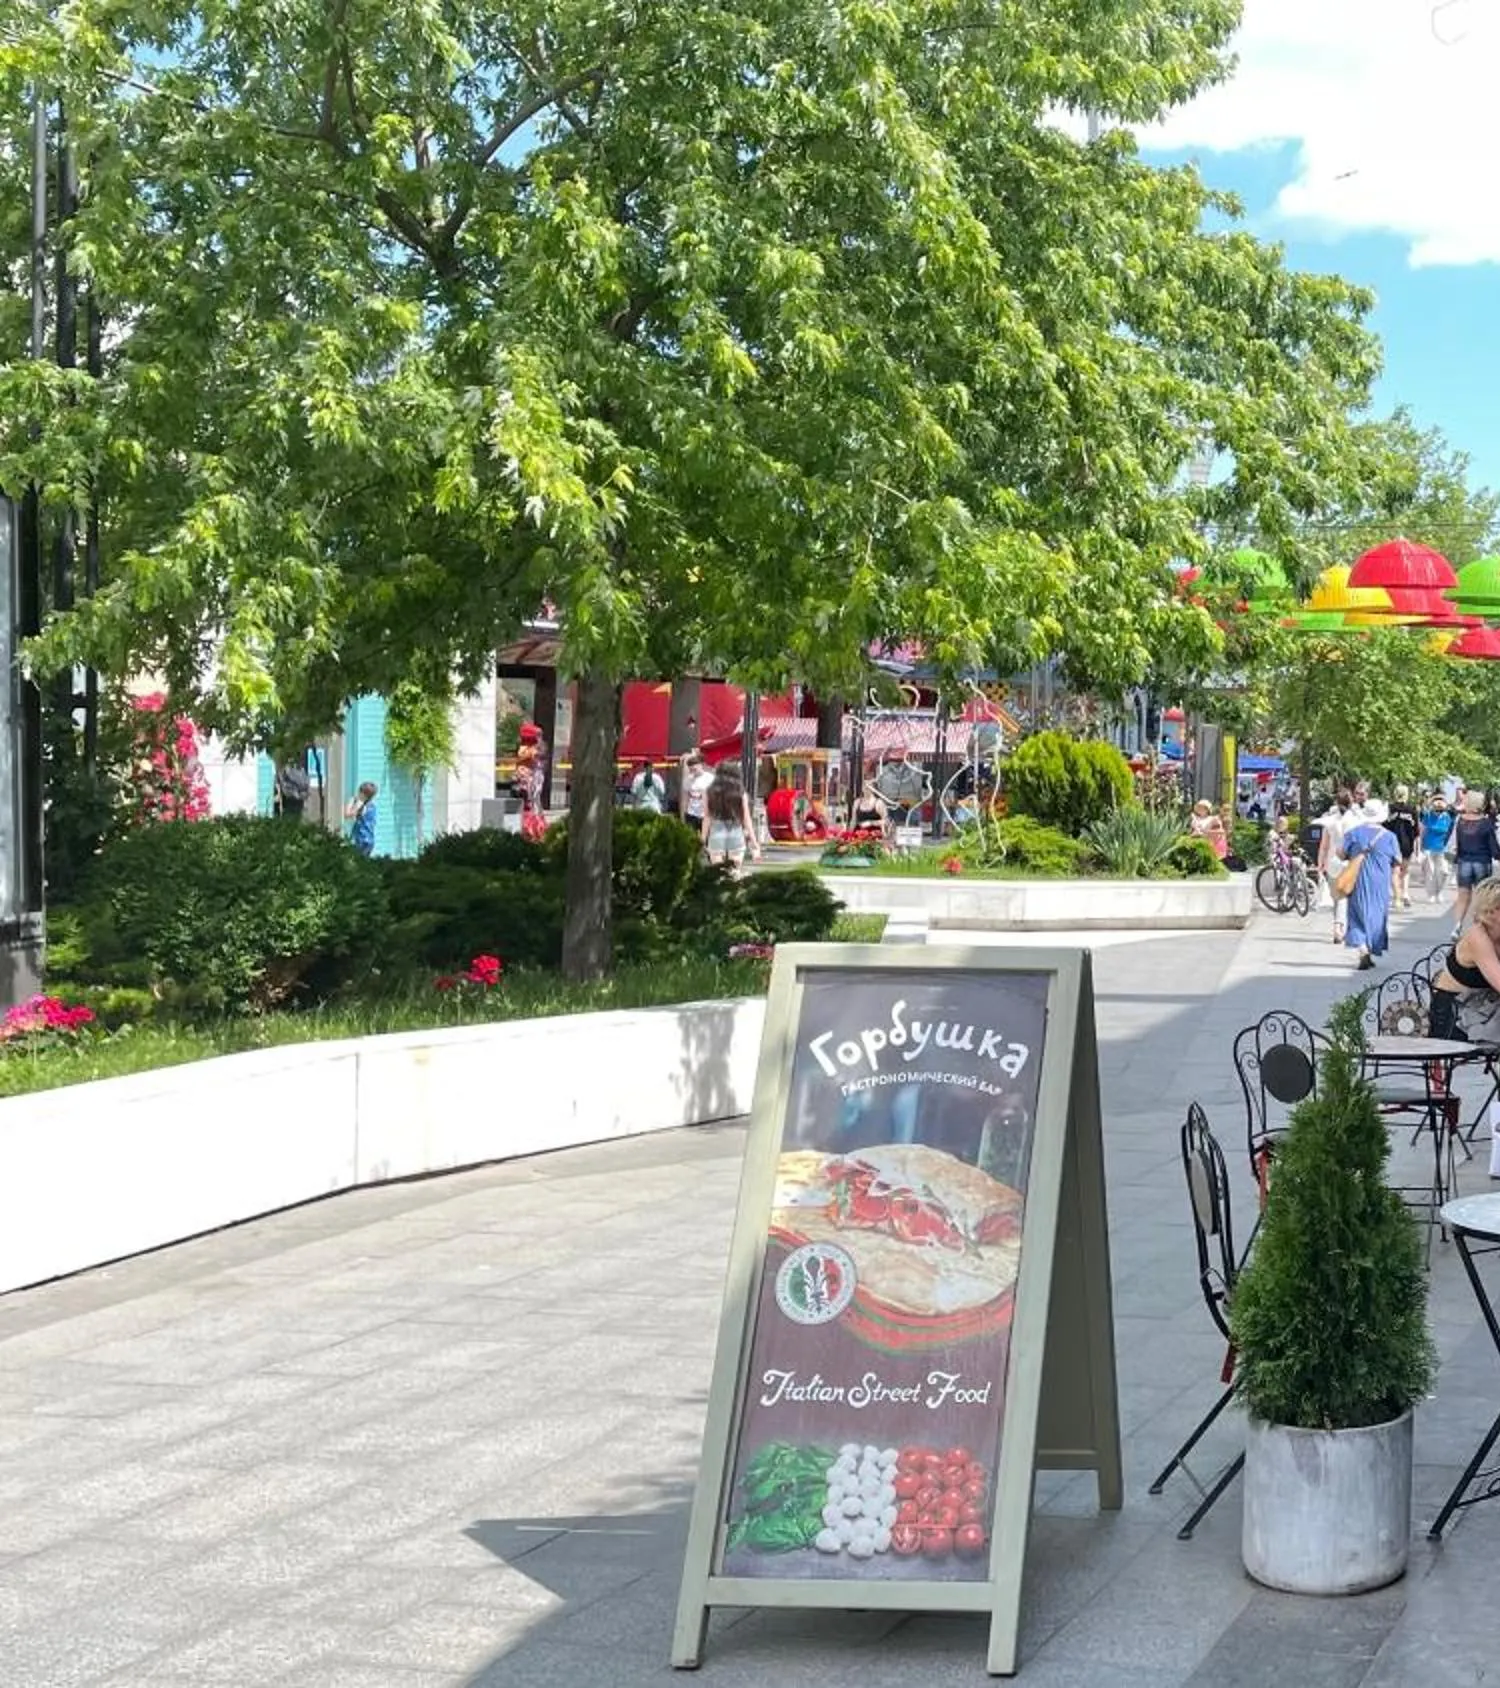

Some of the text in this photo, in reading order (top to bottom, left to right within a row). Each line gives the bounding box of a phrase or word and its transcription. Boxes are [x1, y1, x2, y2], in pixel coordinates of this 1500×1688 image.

[809, 1000, 1030, 1079] Горбушка
[841, 1071, 1004, 1097] ГАСТРОНОМИЧЕСКИЙ БАР
[760, 1369, 992, 1409] Italian Street Food
